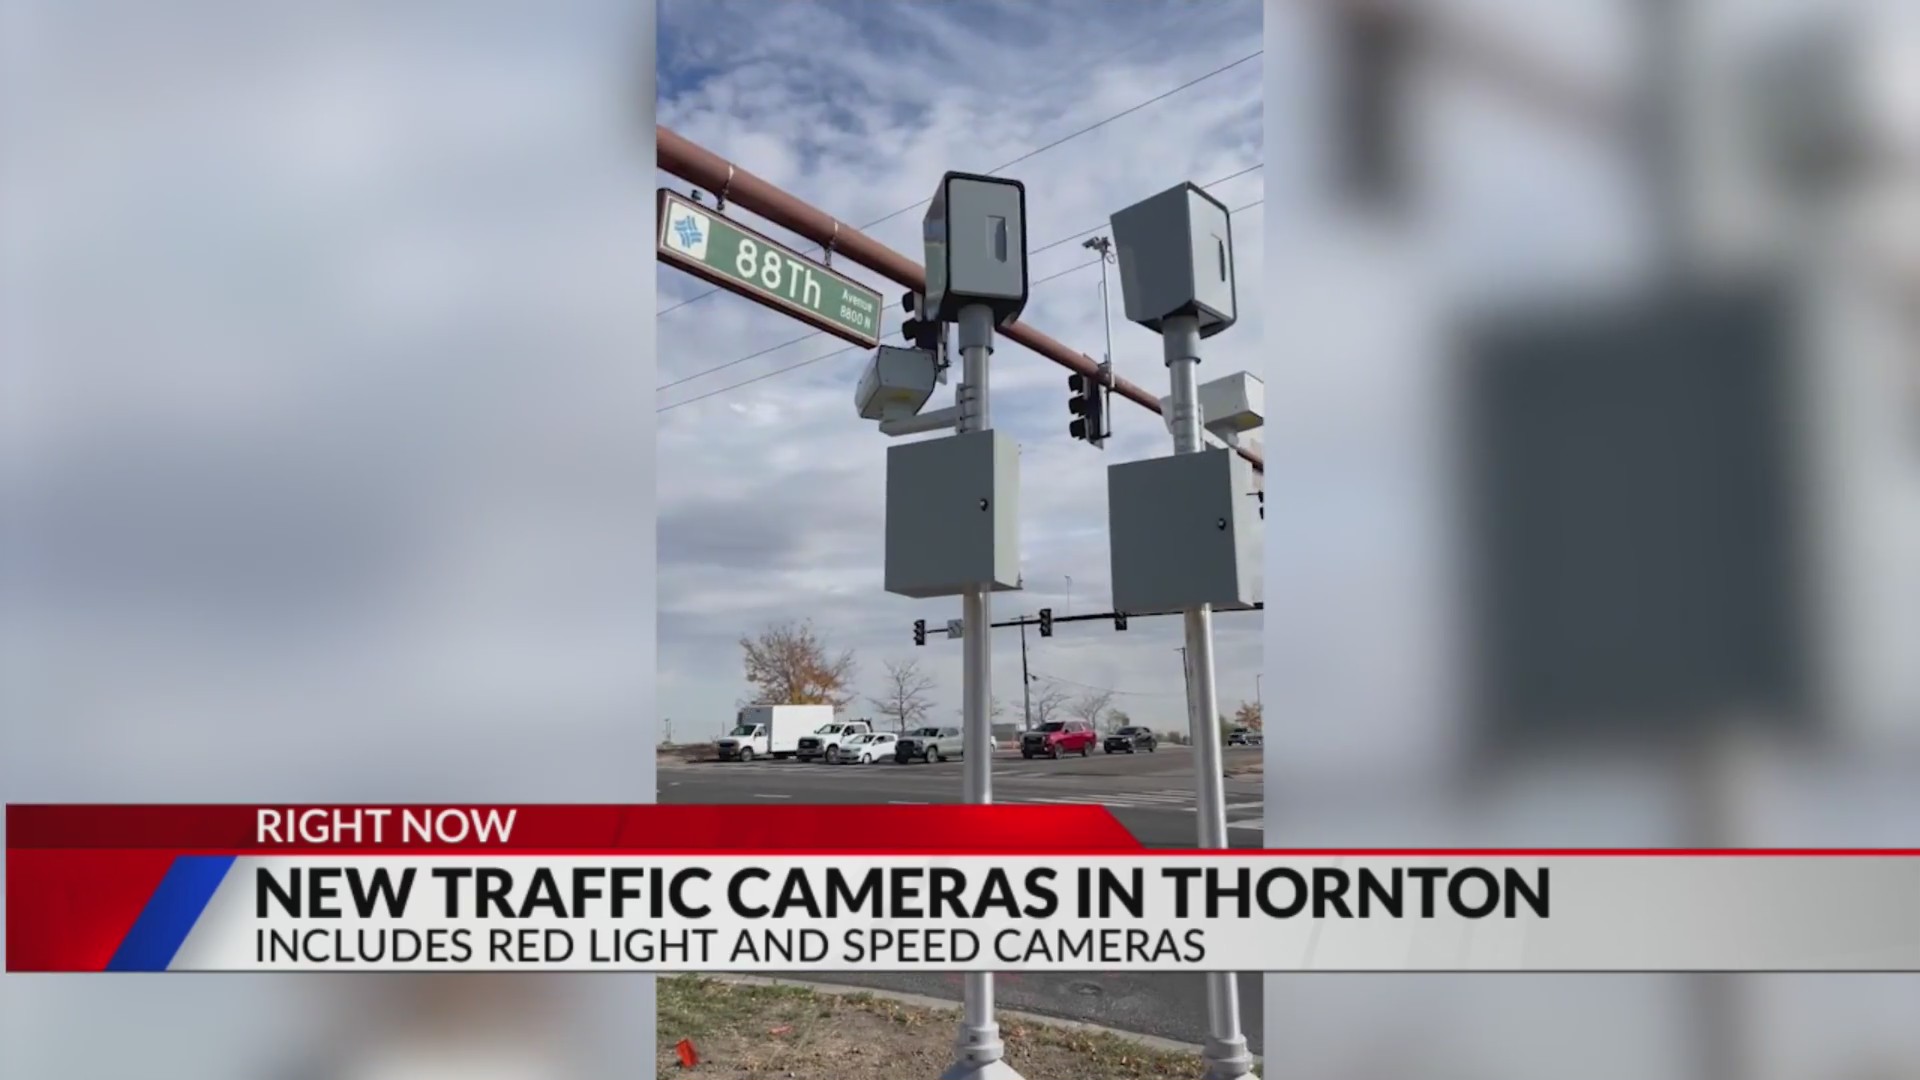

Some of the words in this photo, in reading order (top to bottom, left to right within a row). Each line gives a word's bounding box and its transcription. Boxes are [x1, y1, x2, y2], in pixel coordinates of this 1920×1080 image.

[736, 239, 821, 309] 88Th
[842, 288, 872, 313] Avenue
[840, 304, 863, 325] 8800
[864, 316, 871, 329] N
